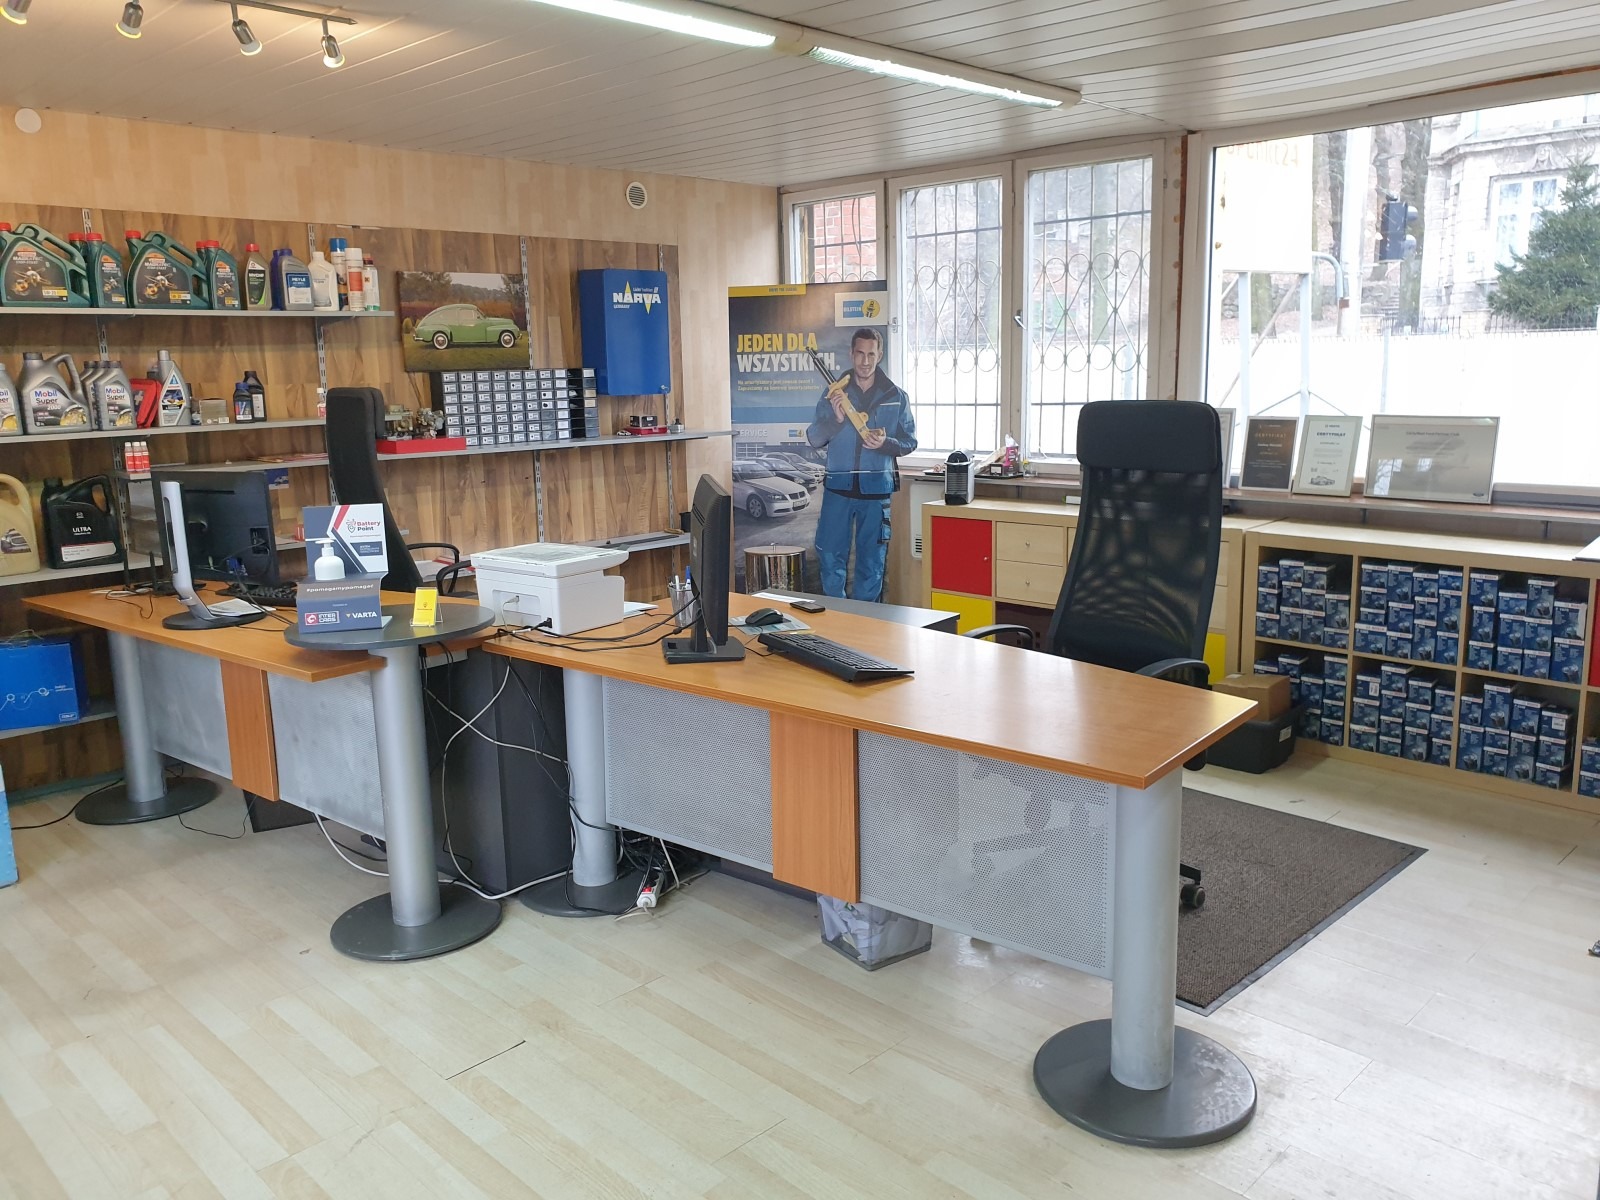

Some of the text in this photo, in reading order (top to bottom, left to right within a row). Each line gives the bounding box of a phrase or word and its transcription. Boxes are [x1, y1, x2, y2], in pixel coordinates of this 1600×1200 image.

[736, 333, 818, 352] JEDEN DLA
[36, 397, 58, 405] Super
[352, 611, 377, 619] VARTA
